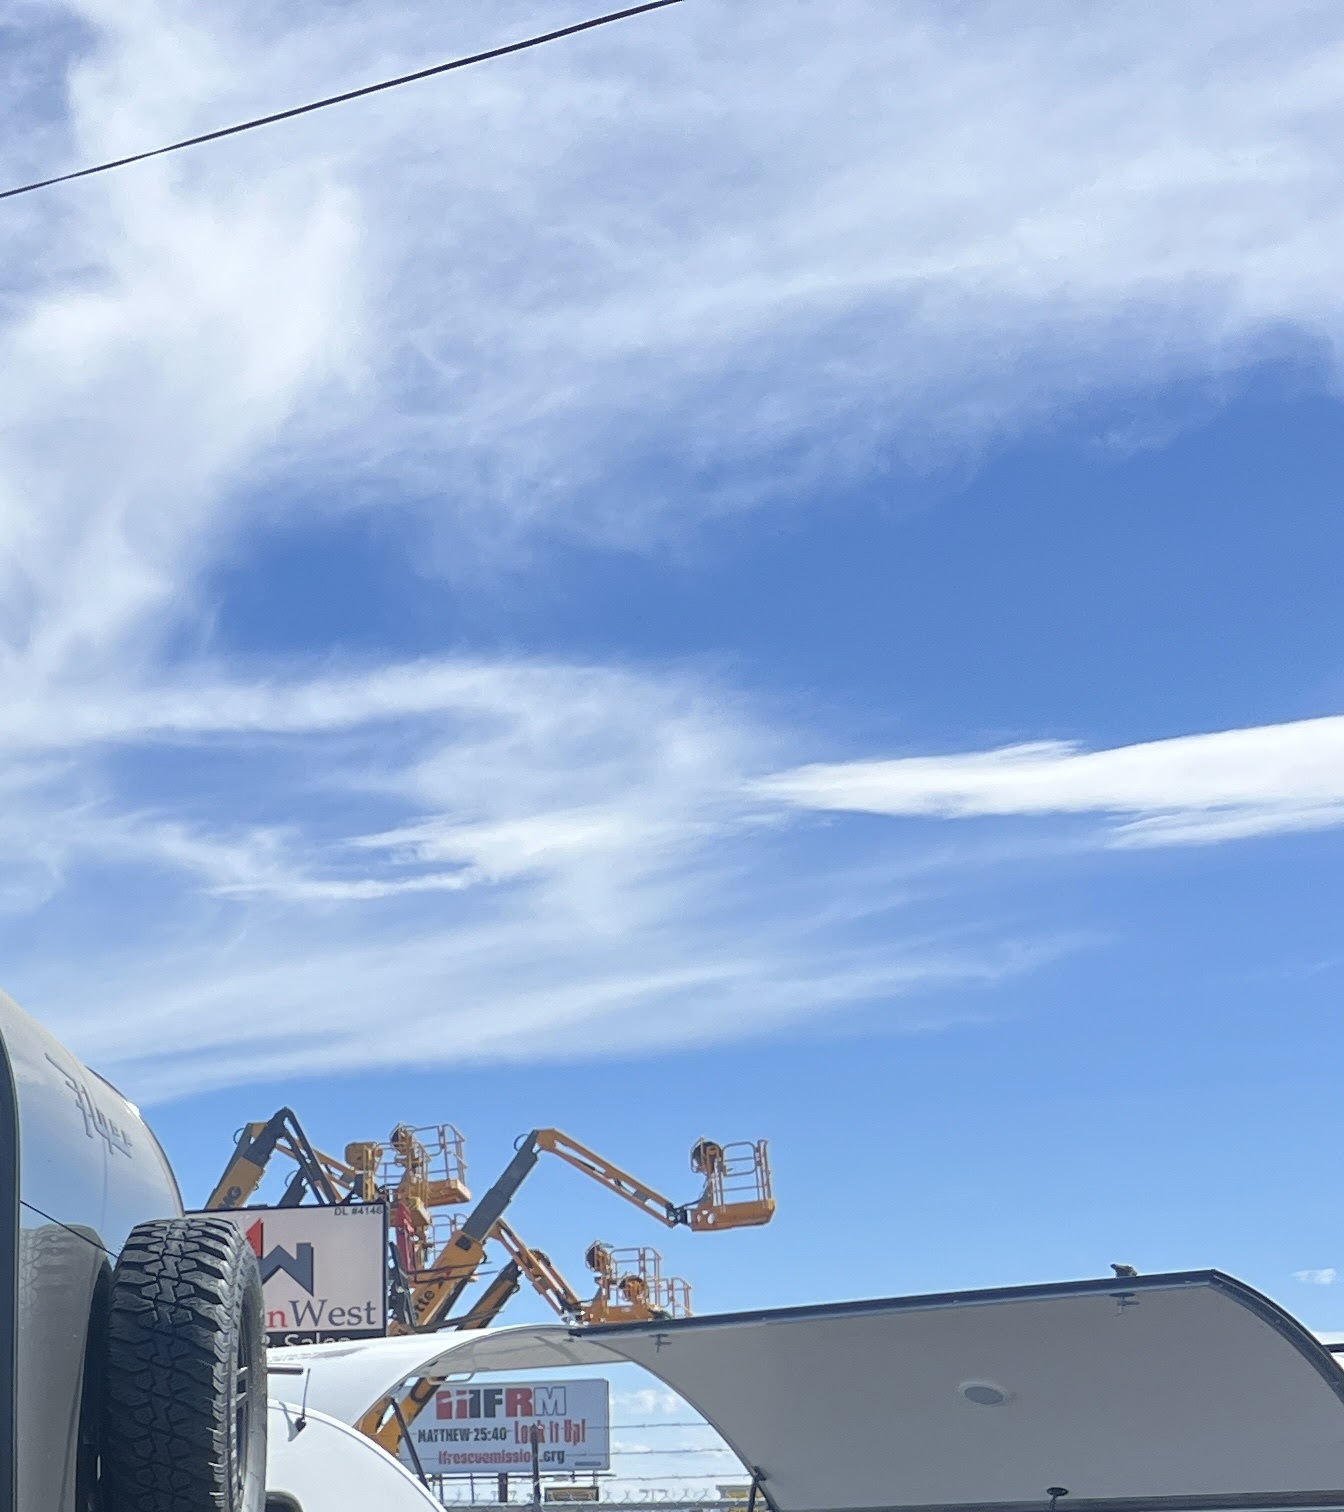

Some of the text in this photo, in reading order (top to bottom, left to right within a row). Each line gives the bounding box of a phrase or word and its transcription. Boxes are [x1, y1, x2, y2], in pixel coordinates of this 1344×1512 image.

[266, 1299, 377, 1329] nWest
[418, 1428, 470, 1443] MATTHEW
[473, 1427, 507, 1442] 25:40
[438, 1449, 565, 1465] ifrescuemissio.org
